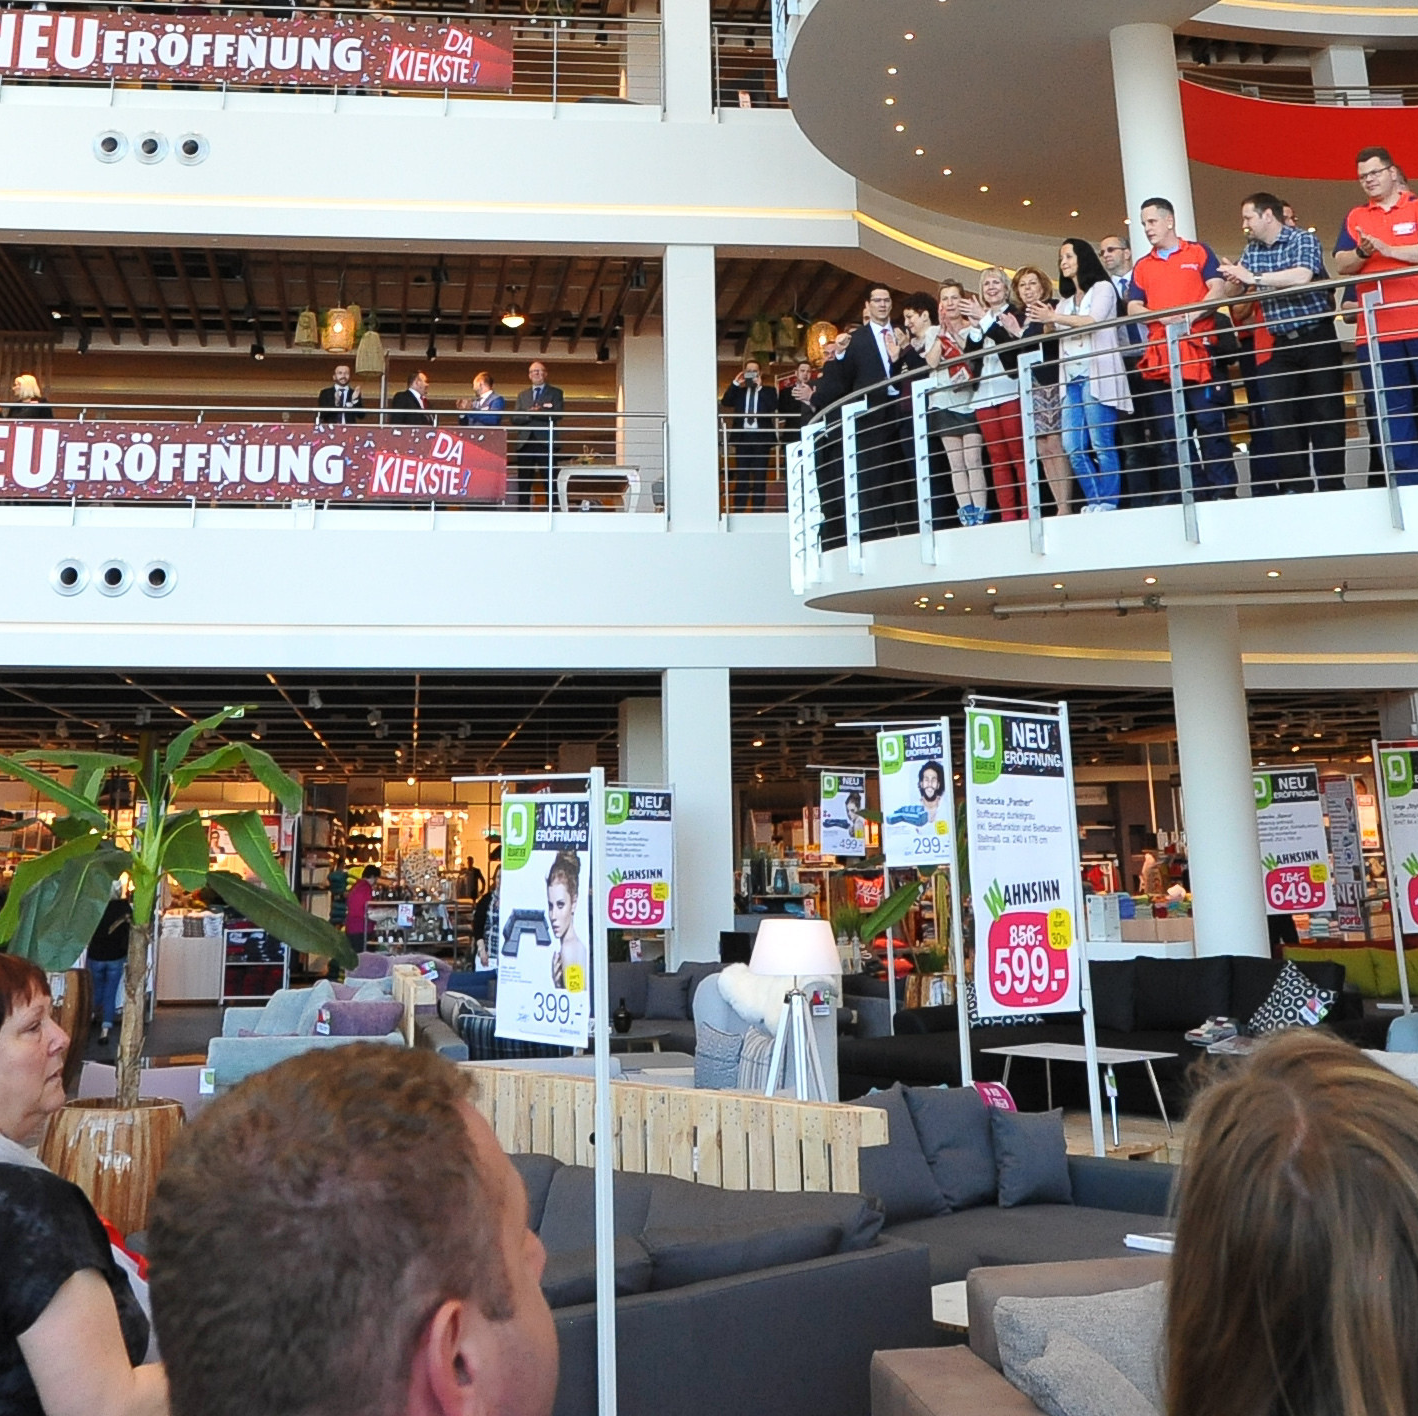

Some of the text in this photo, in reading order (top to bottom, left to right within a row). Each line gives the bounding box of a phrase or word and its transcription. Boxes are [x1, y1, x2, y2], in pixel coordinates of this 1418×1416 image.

[444, 28, 473, 58] DA
[387, 46, 480, 83] KIEKSTE!
[432, 432, 464, 462] DA
[372, 453, 470, 495] KIEKSTE!
[910, 734, 936, 748] NEU
[1011, 721, 1050, 749] NEU
[1004, 747, 1062, 767] ERÖFFNUNG
[1278, 776, 1308, 790] NEU
[635, 796, 664, 809] NEU
[544, 804, 579, 827] NEU
[536, 827, 587, 842] ERÖFFNUNG
[1261, 850, 1319, 872] WAHNSINN
[607, 868, 663, 886] WAHNSINN
[983, 878, 1060, 922] WAHNSINN
[1270, 883, 1323, 905] 649.-
[611, 899, 662, 920] 599.-
[994, 946, 1066, 995] 599.-
